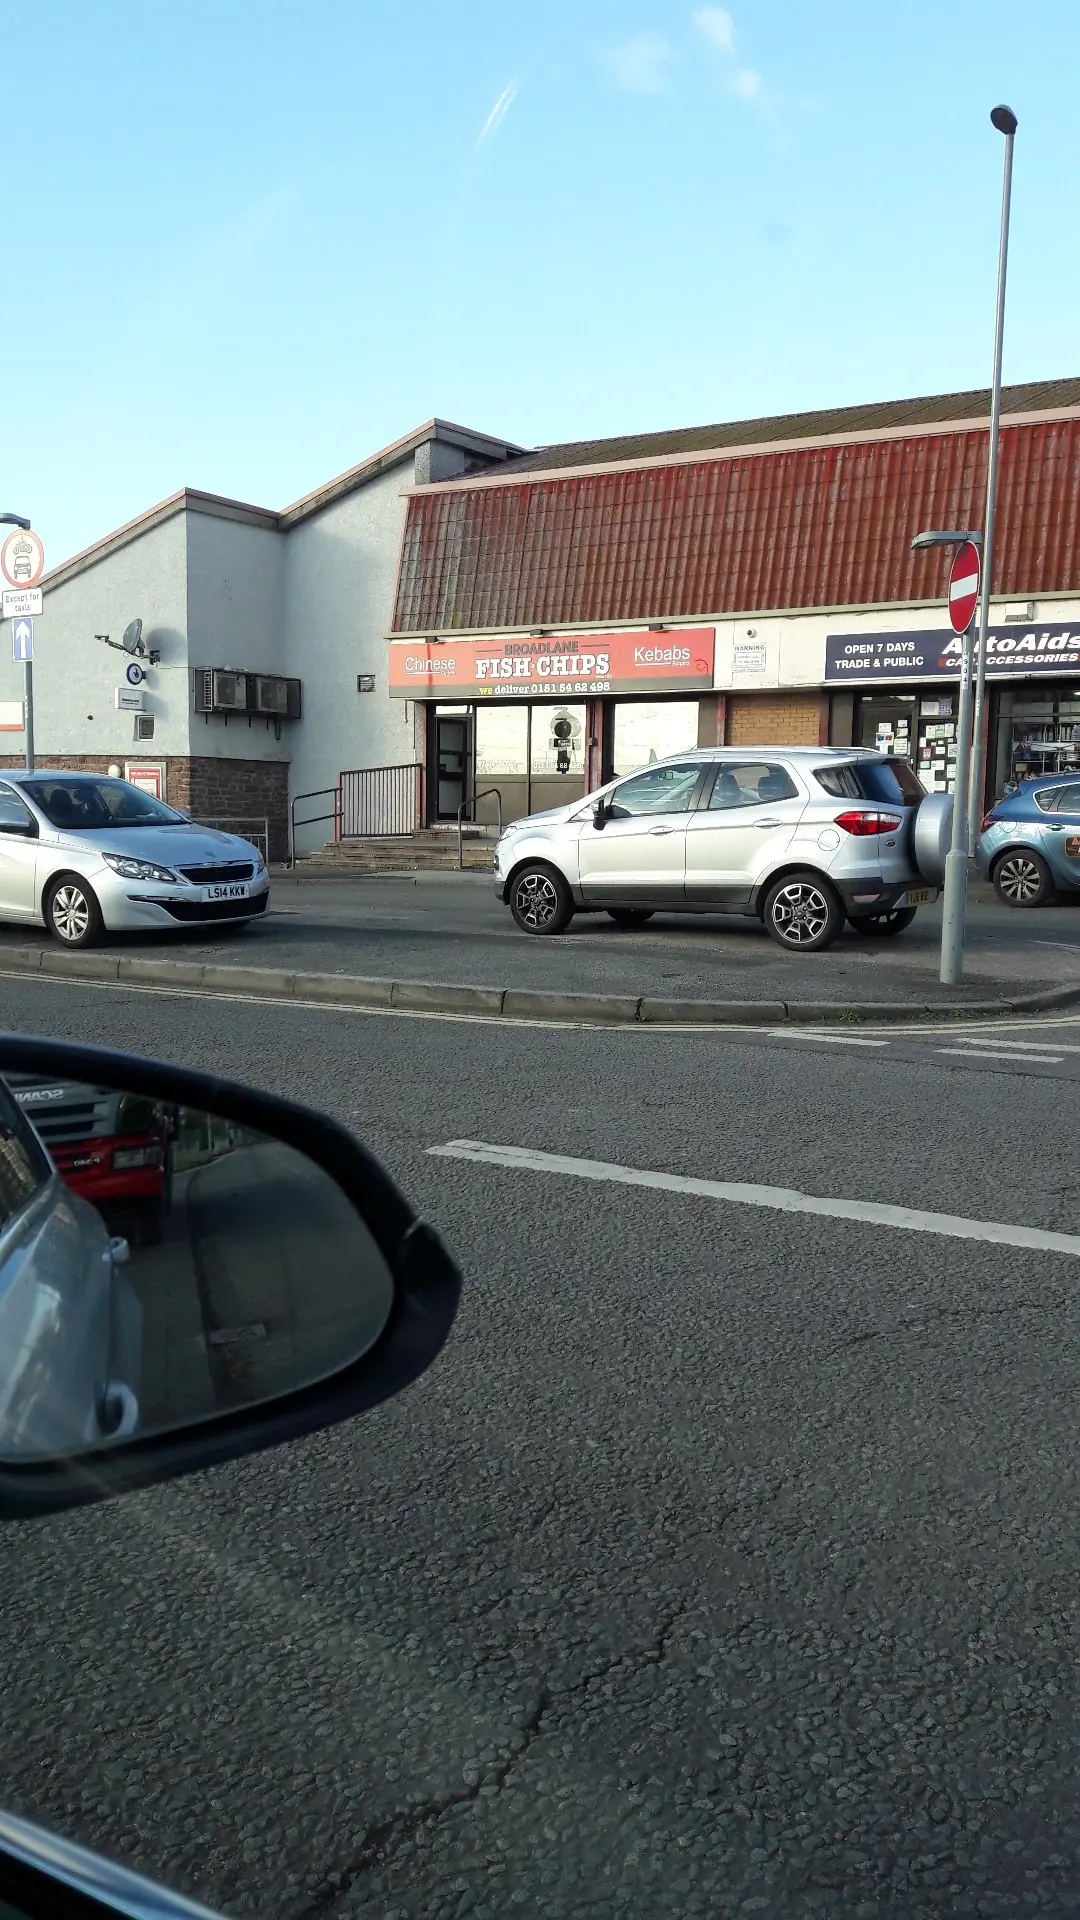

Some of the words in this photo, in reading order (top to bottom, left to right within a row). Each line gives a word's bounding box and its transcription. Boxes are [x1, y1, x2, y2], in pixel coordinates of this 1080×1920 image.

[5, 594, 28, 603] Except
[29, 593, 40, 601] for
[504, 641, 579, 656] BROADLANE
[734, 644, 765, 652] WARNING
[844, 643, 874, 655] OPEN
[876, 643, 884, 653] 7
[886, 641, 916, 652] DAYS
[941, 632, 1080, 655] AtoAids
[634, 644, 690, 662] Kebabs
[976, 652, 1079, 666] CCESSORIES
[405, 656, 456, 671] Chinese
[475, 656, 532, 679] FISH
[536, 653, 610, 677] CHIPS
[834, 658, 871, 670] TRADE
[873, 658, 881, 668] &
[883, 656, 924, 667] PUBLIC
[479, 686, 493, 695] we
[494, 684, 530, 695] deliver
[589, 681, 610, 692] 498
